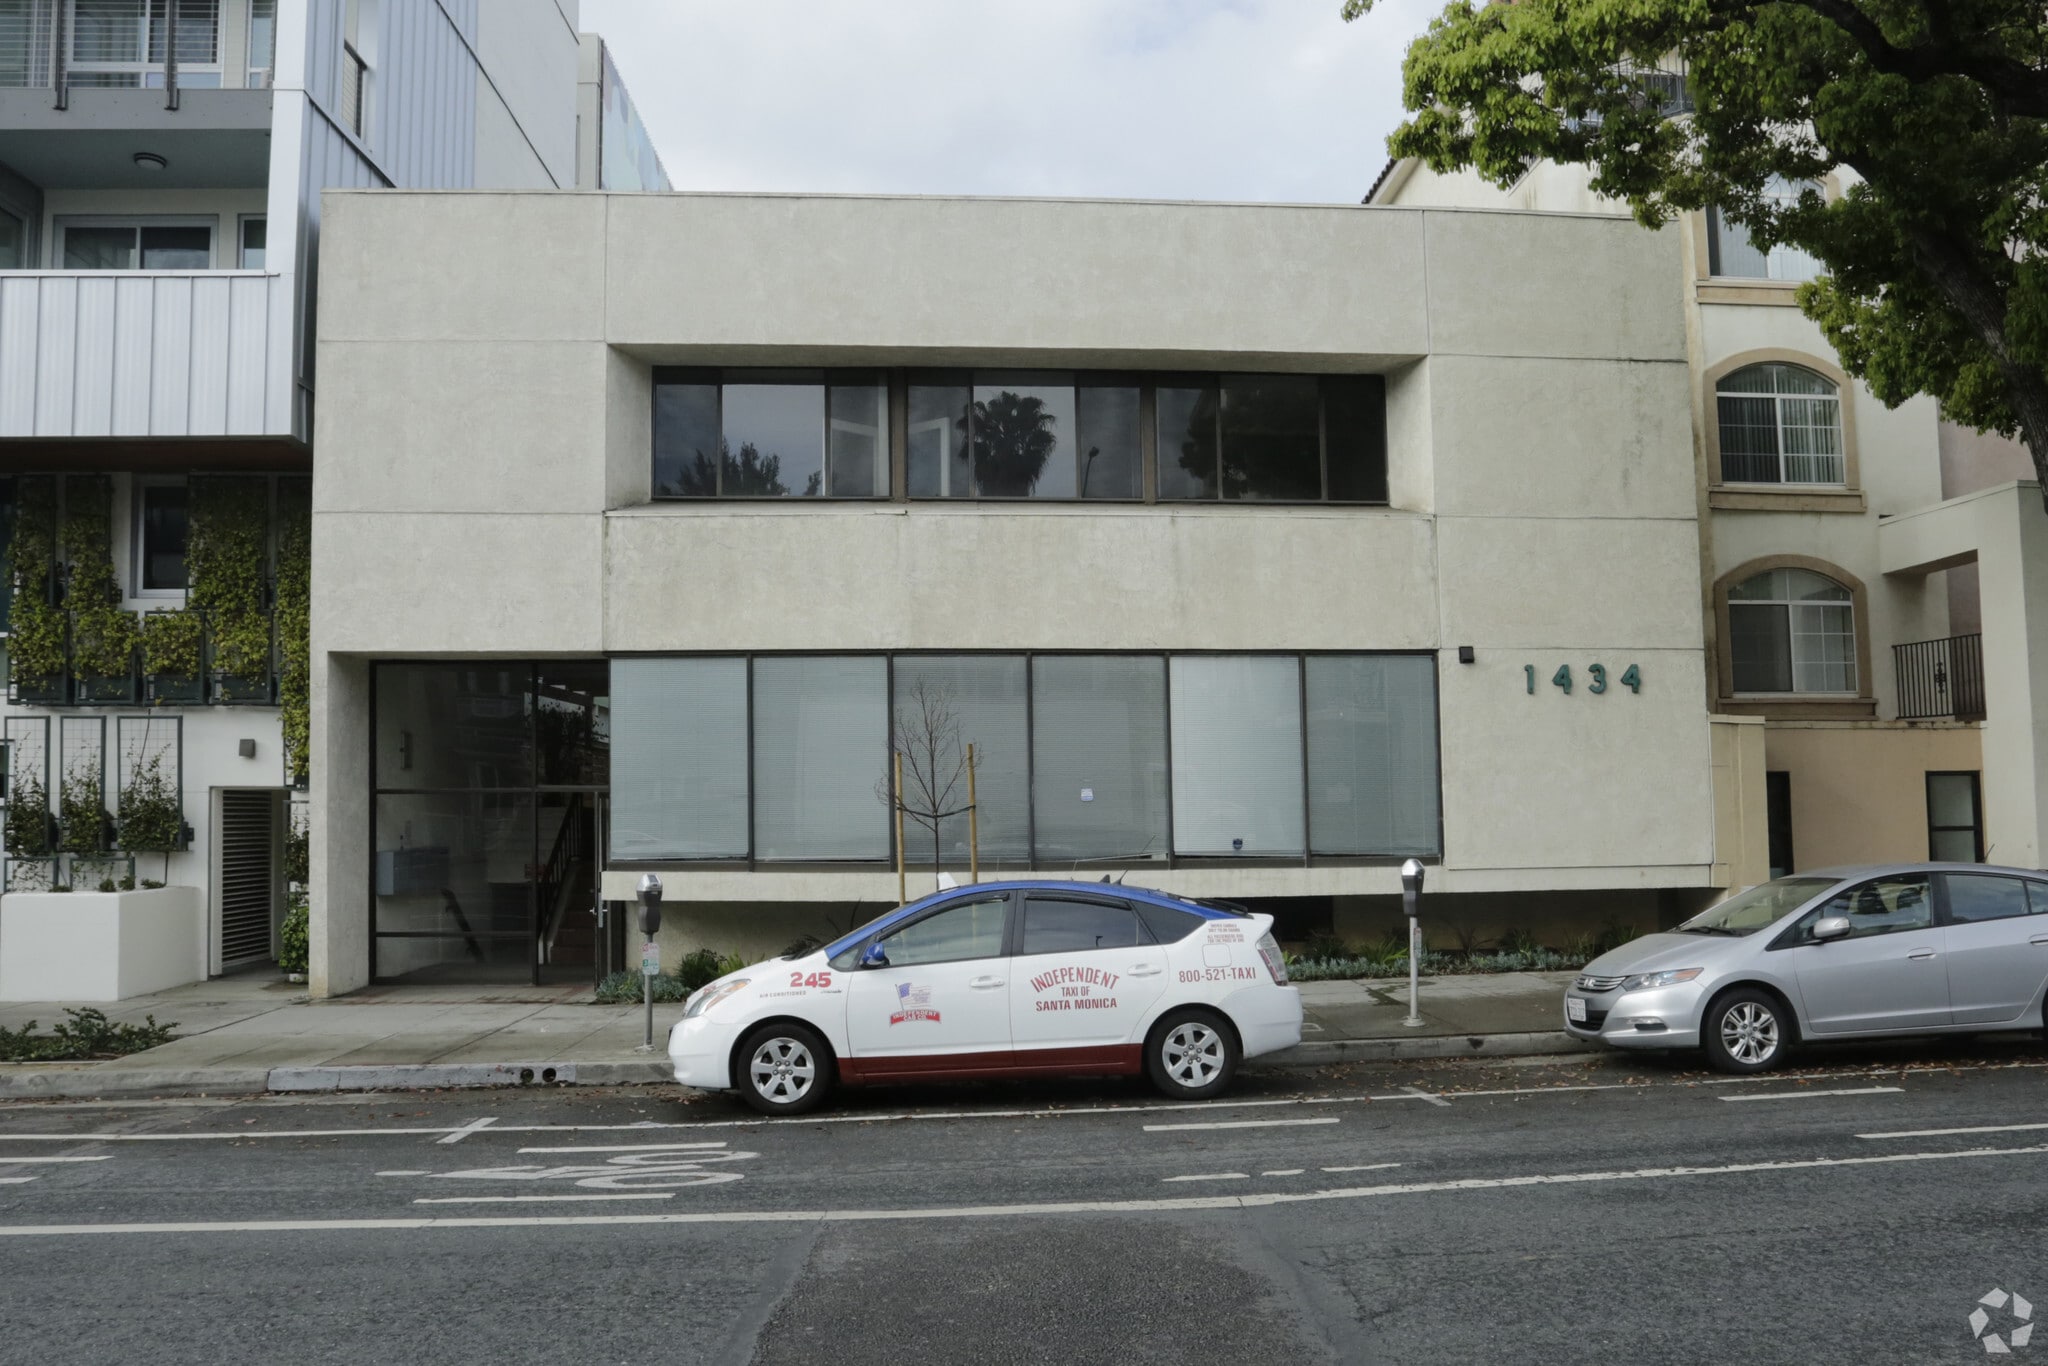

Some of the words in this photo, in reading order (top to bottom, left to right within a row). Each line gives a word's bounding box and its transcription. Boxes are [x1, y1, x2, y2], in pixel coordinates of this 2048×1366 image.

[1524, 664, 1641, 695] 1434
[790, 971, 832, 988] 245
[1030, 967, 1120, 993] INDEPENDENT
[1179, 967, 1256, 983] 800-521-TAXI
[1061, 986, 1078, 997] TAXI
[1081, 986, 1090, 996] OF
[1036, 1000, 1071, 1012] SANTA
[1074, 998, 1117, 1010] MONICA
